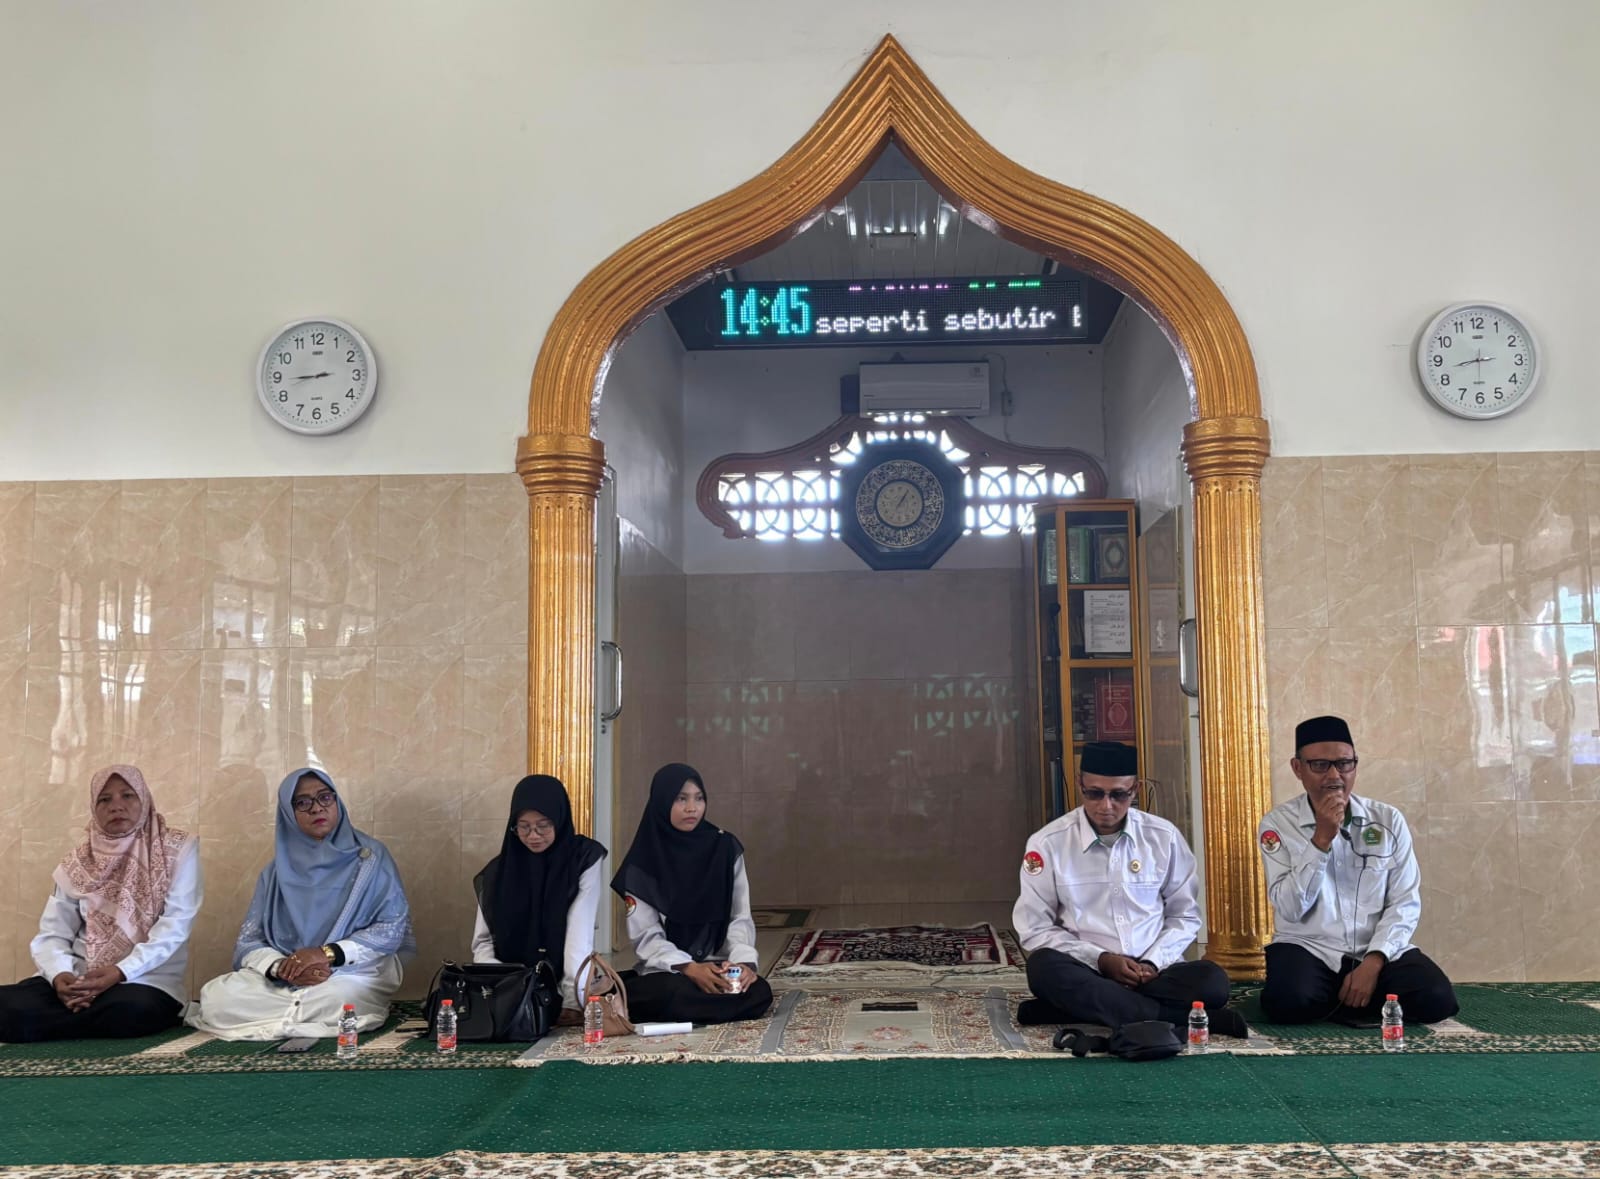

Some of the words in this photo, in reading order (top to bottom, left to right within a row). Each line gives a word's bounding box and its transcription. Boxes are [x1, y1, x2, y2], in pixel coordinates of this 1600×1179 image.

[720, 286, 810, 336] 14:45
[815, 308, 929, 334] seperti
[944, 305, 1057, 331] sebutir
[1469, 317, 1485, 330] 12
[1453, 321, 1464, 334] 11
[1493, 321, 1499, 334] 1
[294, 337, 305, 350] 11
[310, 332, 325, 346] 12
[333, 336, 339, 350] 1
[1437, 335, 1452, 349] 10
[1507, 335, 1517, 348] 2
[278, 351, 292, 365] 10
[346, 350, 356, 363] 2
[1433, 354, 1443, 367] 9
[1513, 353, 1524, 366] 3
[272, 371, 282, 384] 9
[351, 369, 361, 382] 3
[1440, 373, 1450, 386] 8
[1508, 372, 1518, 385] 4
[278, 390, 288, 403] 8
[345, 387, 356, 401] 4
[1458, 388, 1467, 401] 7
[1475, 391, 1485, 405] 6
[1493, 387, 1504, 400] 5
[295, 404, 305, 417] 7
[311, 407, 322, 420] 6
[330, 402, 340, 415] 5
